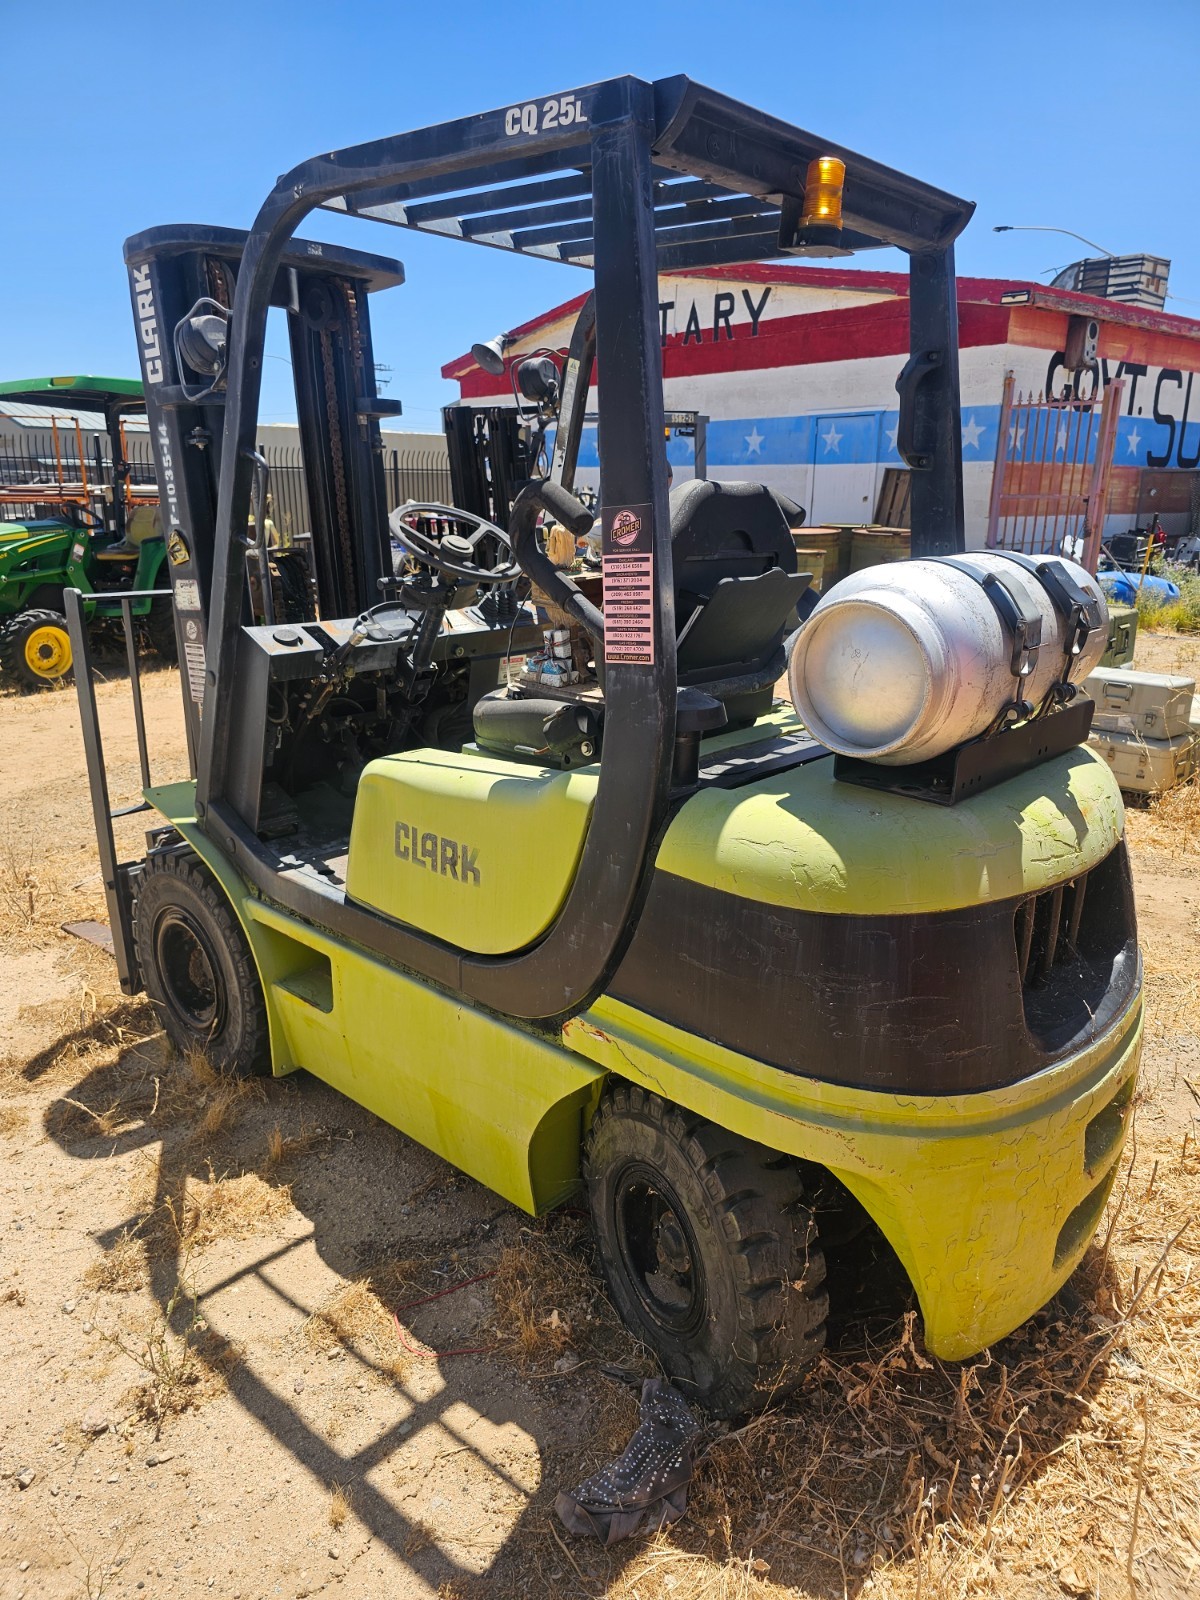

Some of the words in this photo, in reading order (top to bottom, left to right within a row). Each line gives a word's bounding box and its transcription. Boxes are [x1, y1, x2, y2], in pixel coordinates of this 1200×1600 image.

[505, 104, 538, 136] CQ
[542, 95, 588, 129] 25L
[133, 263, 164, 384] CLARK
[612, 520, 640, 539] CROMER
[607, 653, 650, 661] www.Cromer.com
[394, 820, 481, 889] CLARK
